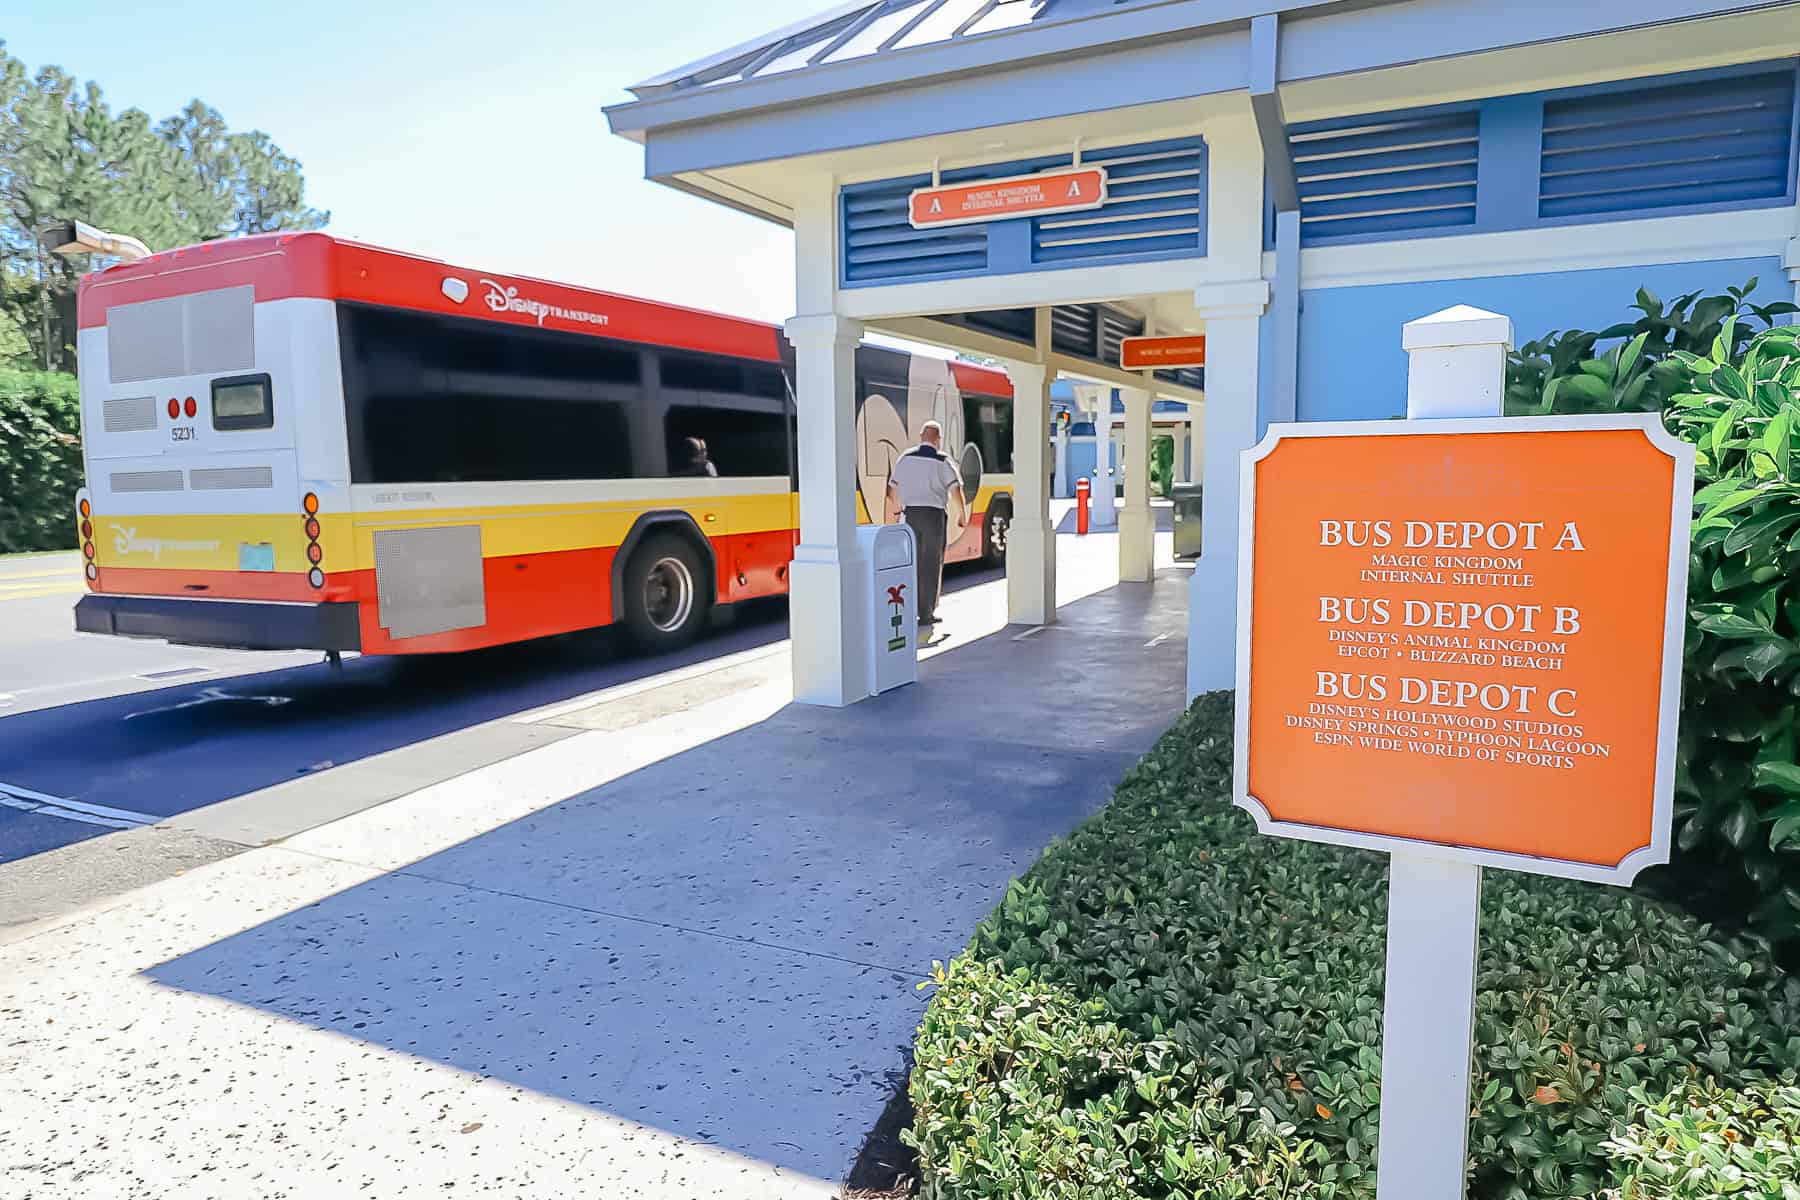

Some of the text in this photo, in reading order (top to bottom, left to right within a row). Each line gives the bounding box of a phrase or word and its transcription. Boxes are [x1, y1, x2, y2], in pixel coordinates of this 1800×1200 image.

[1066, 180, 1081, 197] A
[929, 198, 943, 213] A
[549, 307, 609, 325] TRANSPORT
[171, 427, 195, 441] 5231
[1319, 520, 1585, 551] BUS DEPOT A
[1372, 554, 1523, 570] MAGIC KINGDOM
[1360, 569, 1535, 587] INTERNAL SHUTTLE
[1318, 597, 1581, 635] BUS DEPOT B
[1328, 629, 1567, 655] DISNEY'S ANIMAL KINGDOM
[1338, 645, 1562, 670] EPCOT BLIZZARD BEACH
[1316, 671, 1577, 717] BUS DEPOT C
[1309, 703, 1584, 738] DISNEY'S HOLLYWOOD STUDIOS
[1286, 715, 1610, 756] DISNEY SPRINGS TYPHOON LAGOON
[1314, 731, 1574, 769] ESPN WIDE WORLD OF SPORTS
